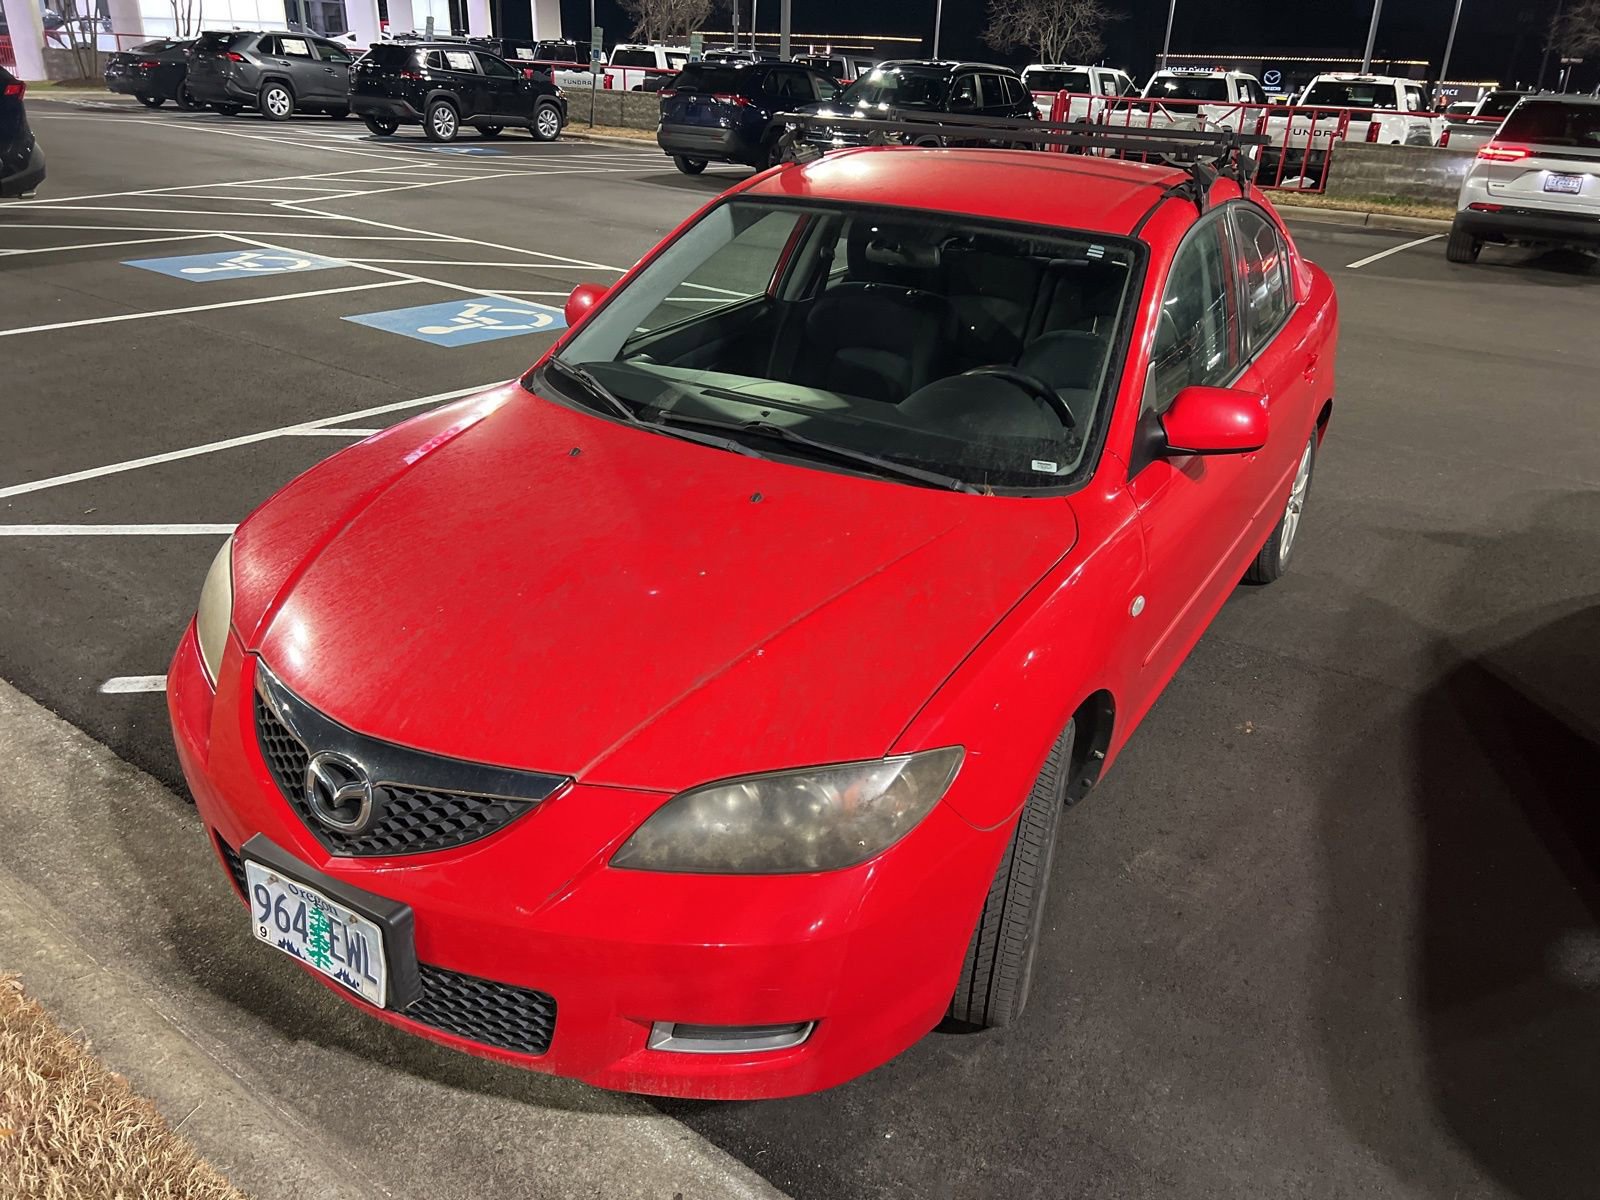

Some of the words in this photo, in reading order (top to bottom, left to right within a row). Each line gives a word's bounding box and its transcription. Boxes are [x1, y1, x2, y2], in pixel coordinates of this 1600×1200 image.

[288, 883, 338, 917] Oregon
[253, 883, 309, 944] 964
[328, 914, 378, 985] EWL
[259, 926, 268, 938] 9
